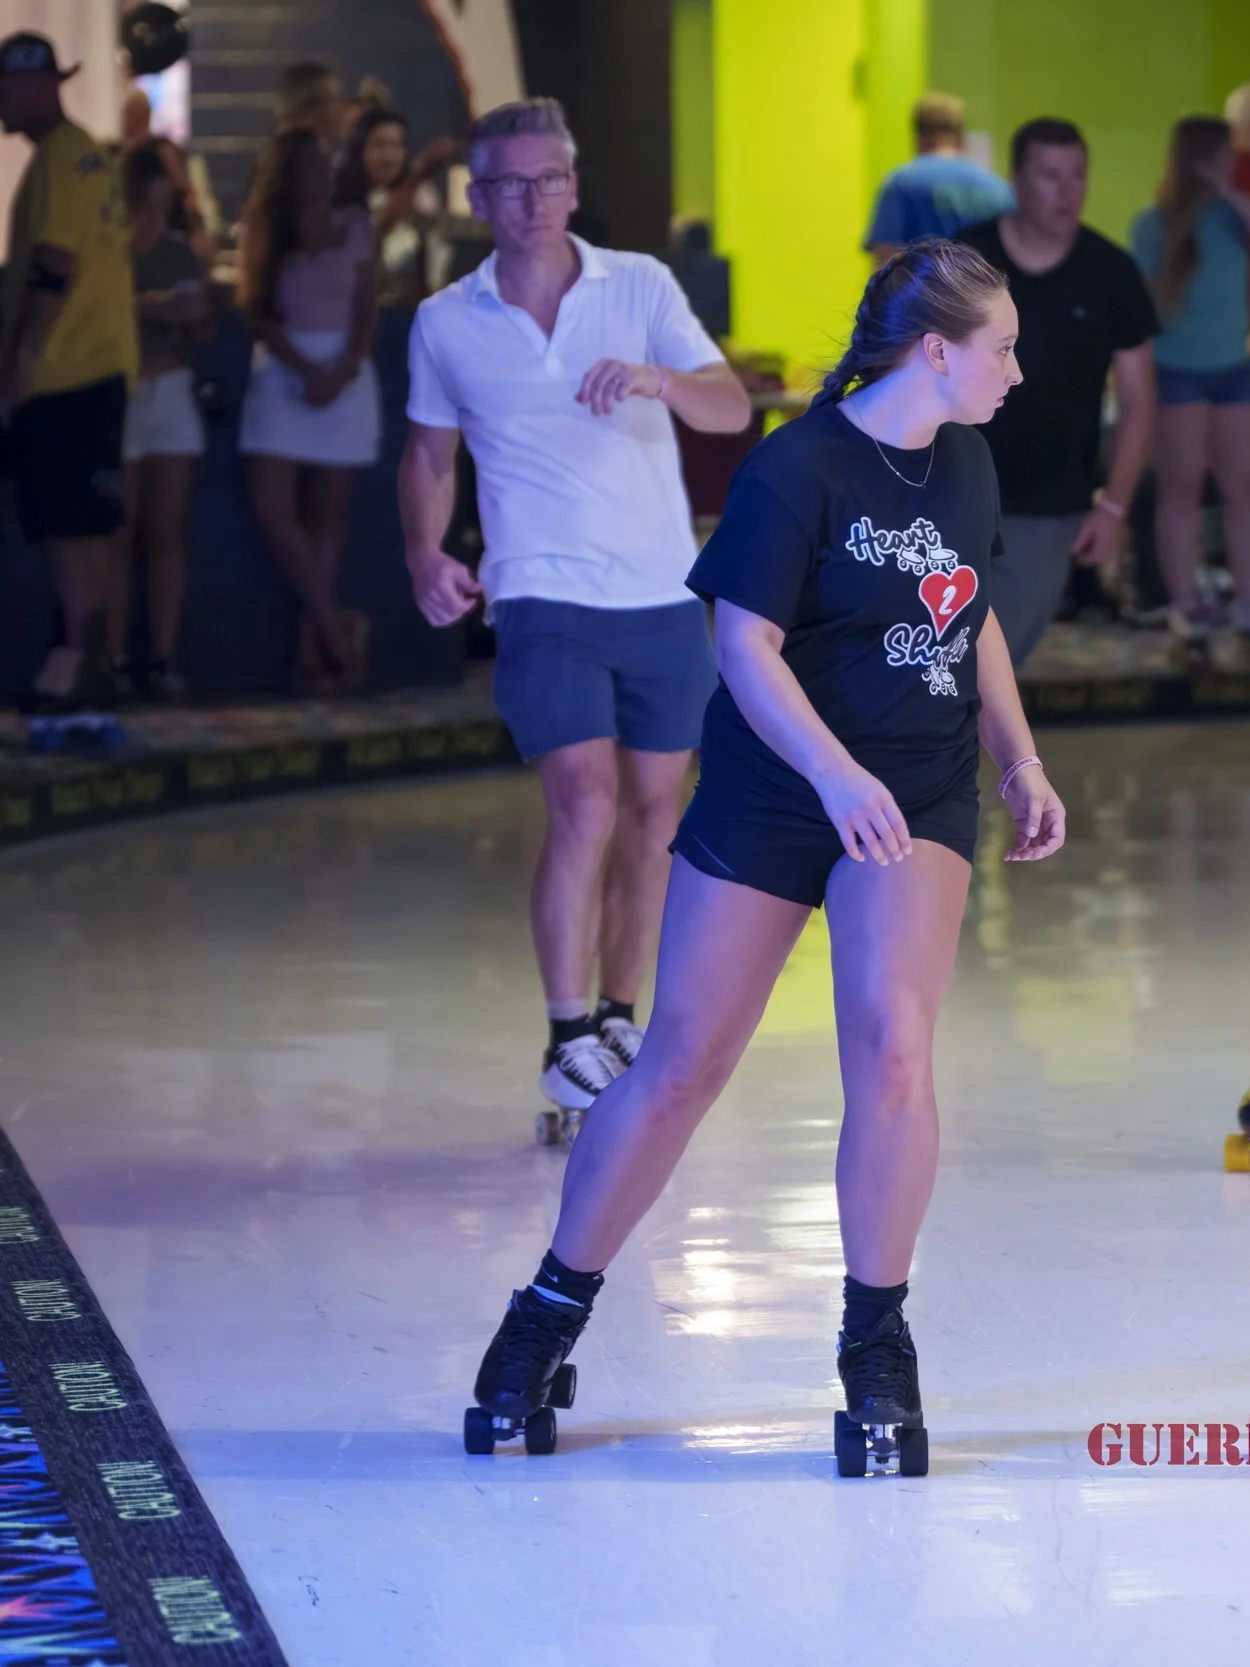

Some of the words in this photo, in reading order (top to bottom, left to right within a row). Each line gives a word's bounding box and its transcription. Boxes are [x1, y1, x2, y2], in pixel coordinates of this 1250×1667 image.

[845, 516, 942, 566] Heart
[938, 585, 957, 615] 2
[48, 1361, 127, 1412] CAUTION!
[96, 1460, 180, 1520] CAUTION!
